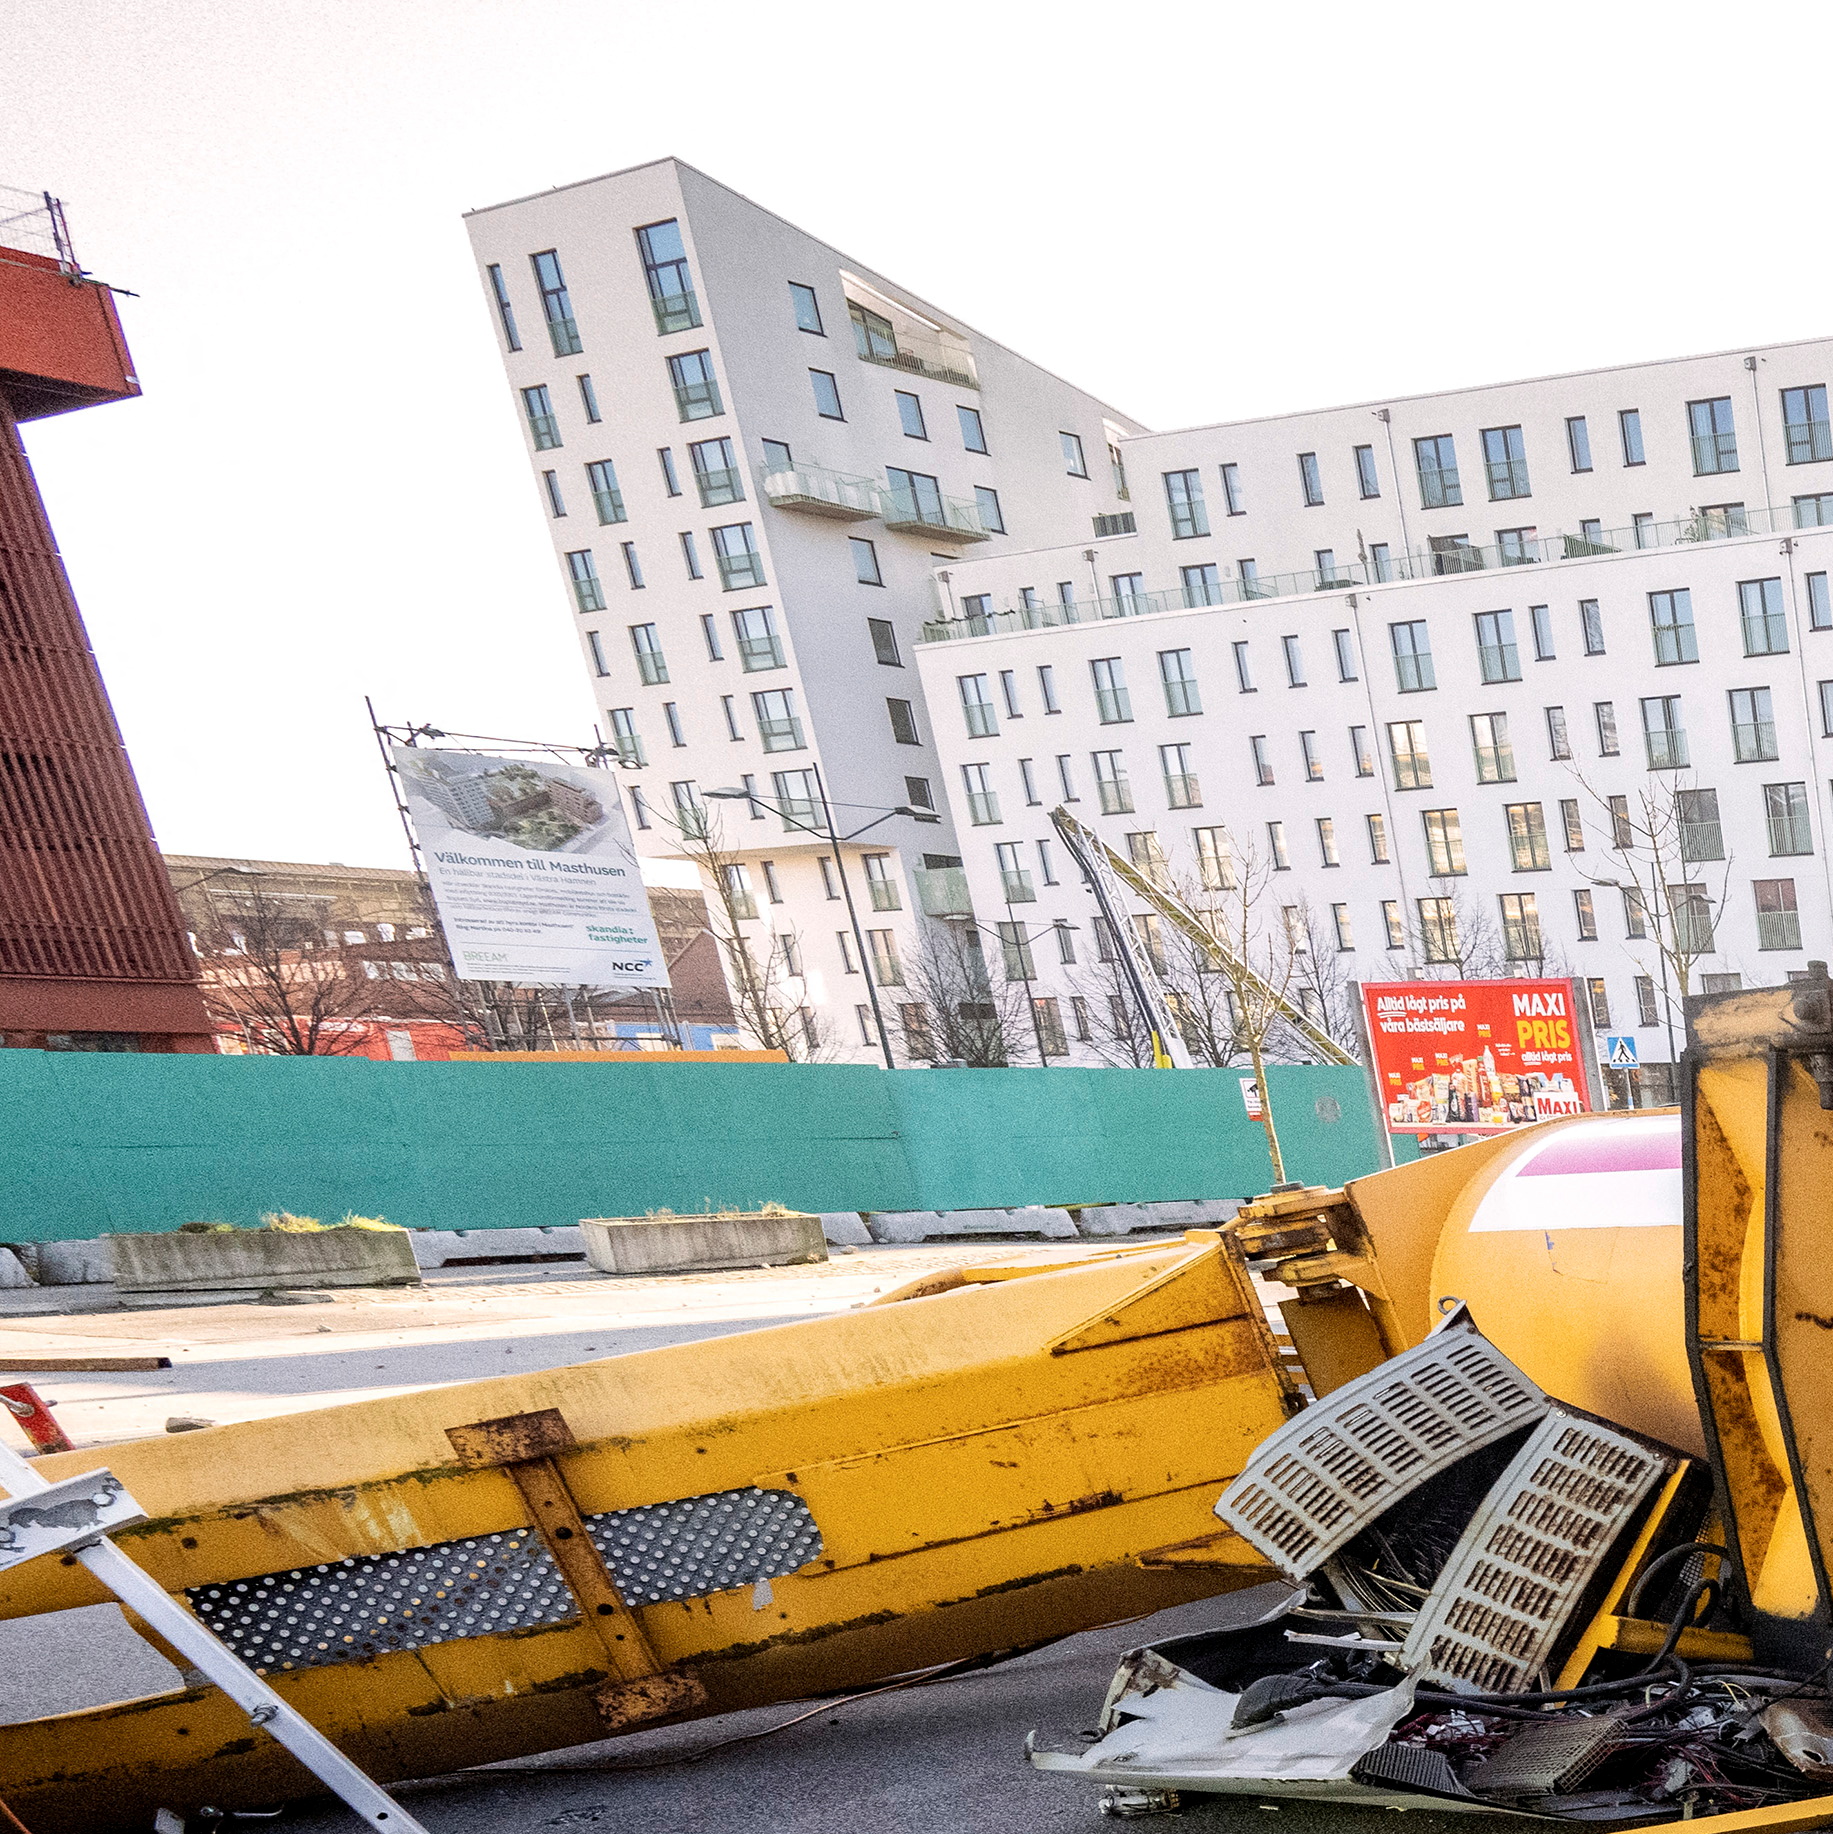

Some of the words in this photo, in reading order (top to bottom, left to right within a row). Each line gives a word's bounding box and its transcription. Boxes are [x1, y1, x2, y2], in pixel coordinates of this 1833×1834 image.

[434, 852, 524, 869] Välkommen
[526, 859, 546, 870] till
[549, 861, 626, 877] Masthusen
[561, 877, 597, 886] Hamnen
[588, 933, 648, 944] fastigheter
[463, 950, 508, 962] BREEAM
[612, 961, 644, 972] NCC
[1377, 996, 1406, 1011] Alltid
[1405, 995, 1428, 1013] lågt
[1428, 995, 1449, 1013] pris
[1450, 993, 1466, 1013] på
[1512, 993, 1566, 1016] MAXI
[1380, 1017, 1406, 1033] våra
[1406, 1017, 1465, 1035] bästsäljare
[1516, 1020, 1571, 1048] PRIS
[1541, 1050, 1557, 1063] lågt
[1558, 1051, 1573, 1063] pris
[1537, 1098, 1578, 1115] MAXI
